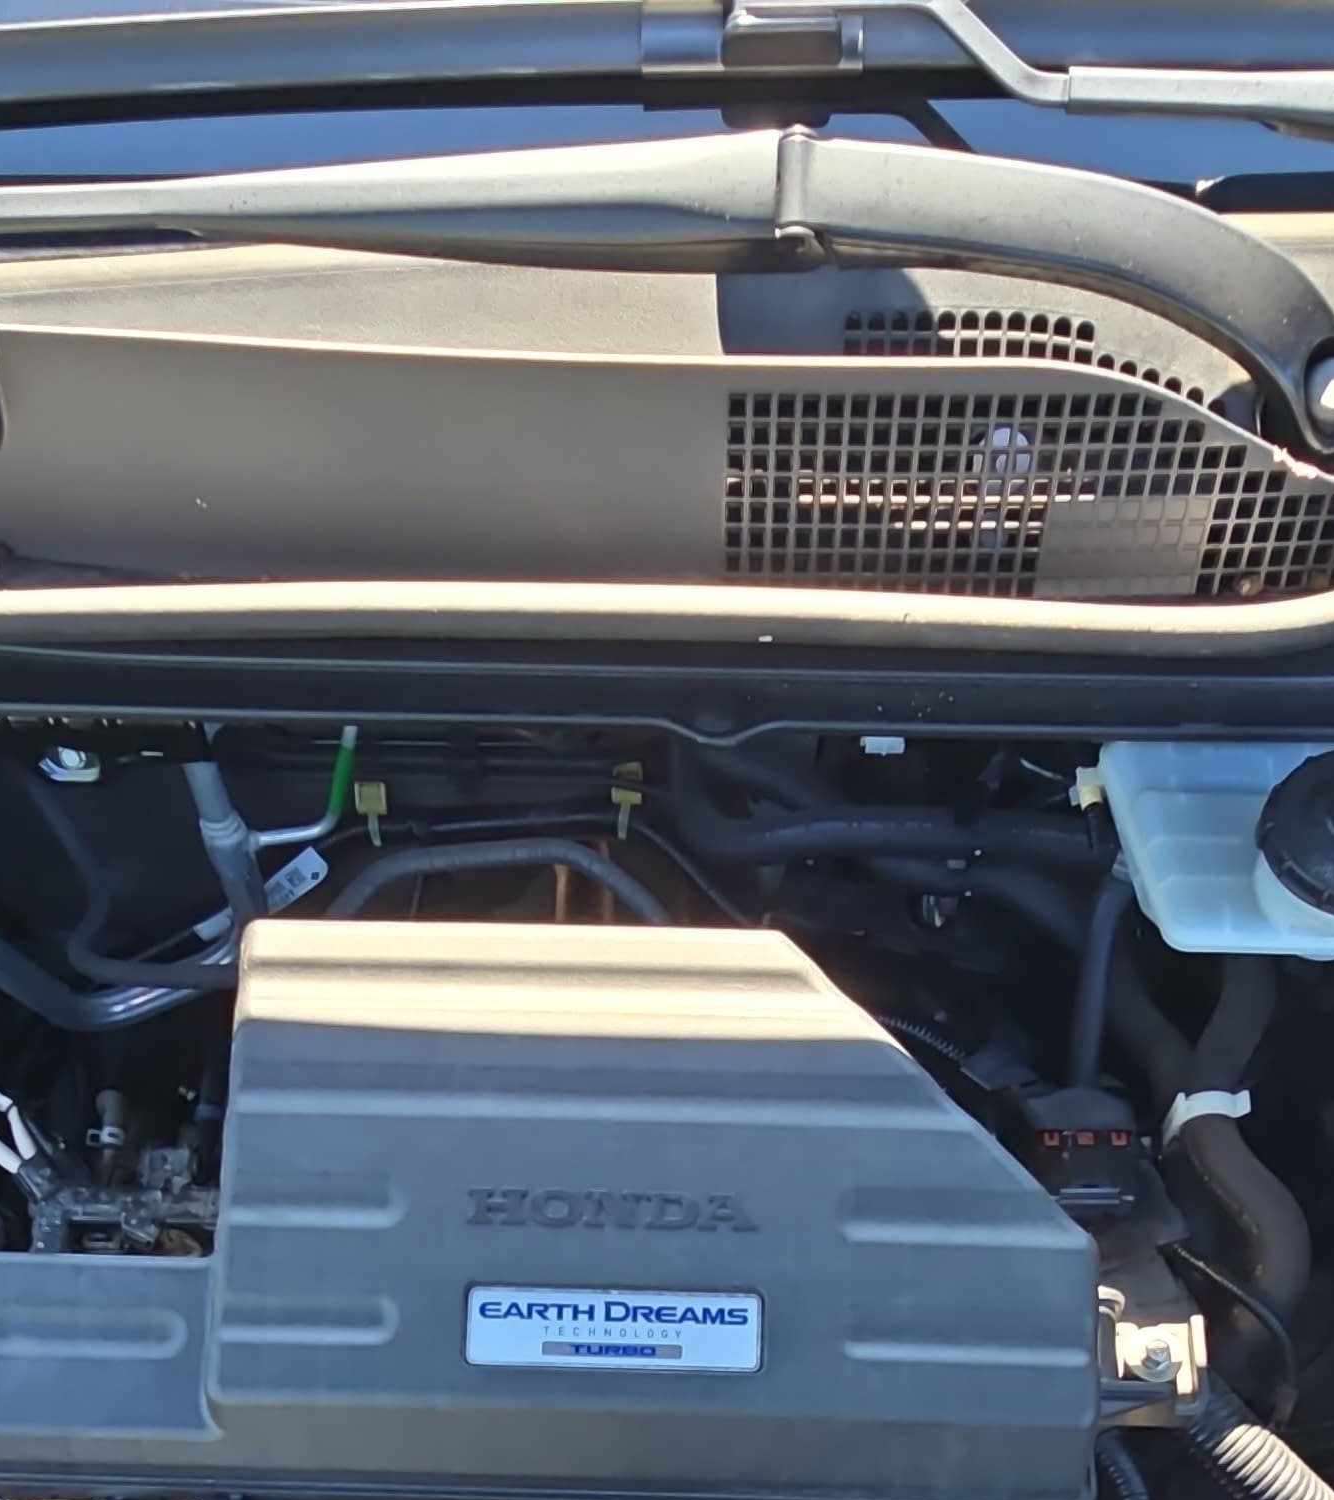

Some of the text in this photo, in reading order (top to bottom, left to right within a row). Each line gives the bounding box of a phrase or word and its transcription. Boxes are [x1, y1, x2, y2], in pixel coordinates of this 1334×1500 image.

[465, 1186, 760, 1233] HONDA
[478, 1300, 749, 1325] EARTH DREAMS
[543, 1326, 683, 1340] TECHNOLOGY
[569, 1343, 656, 1357] TURBO
